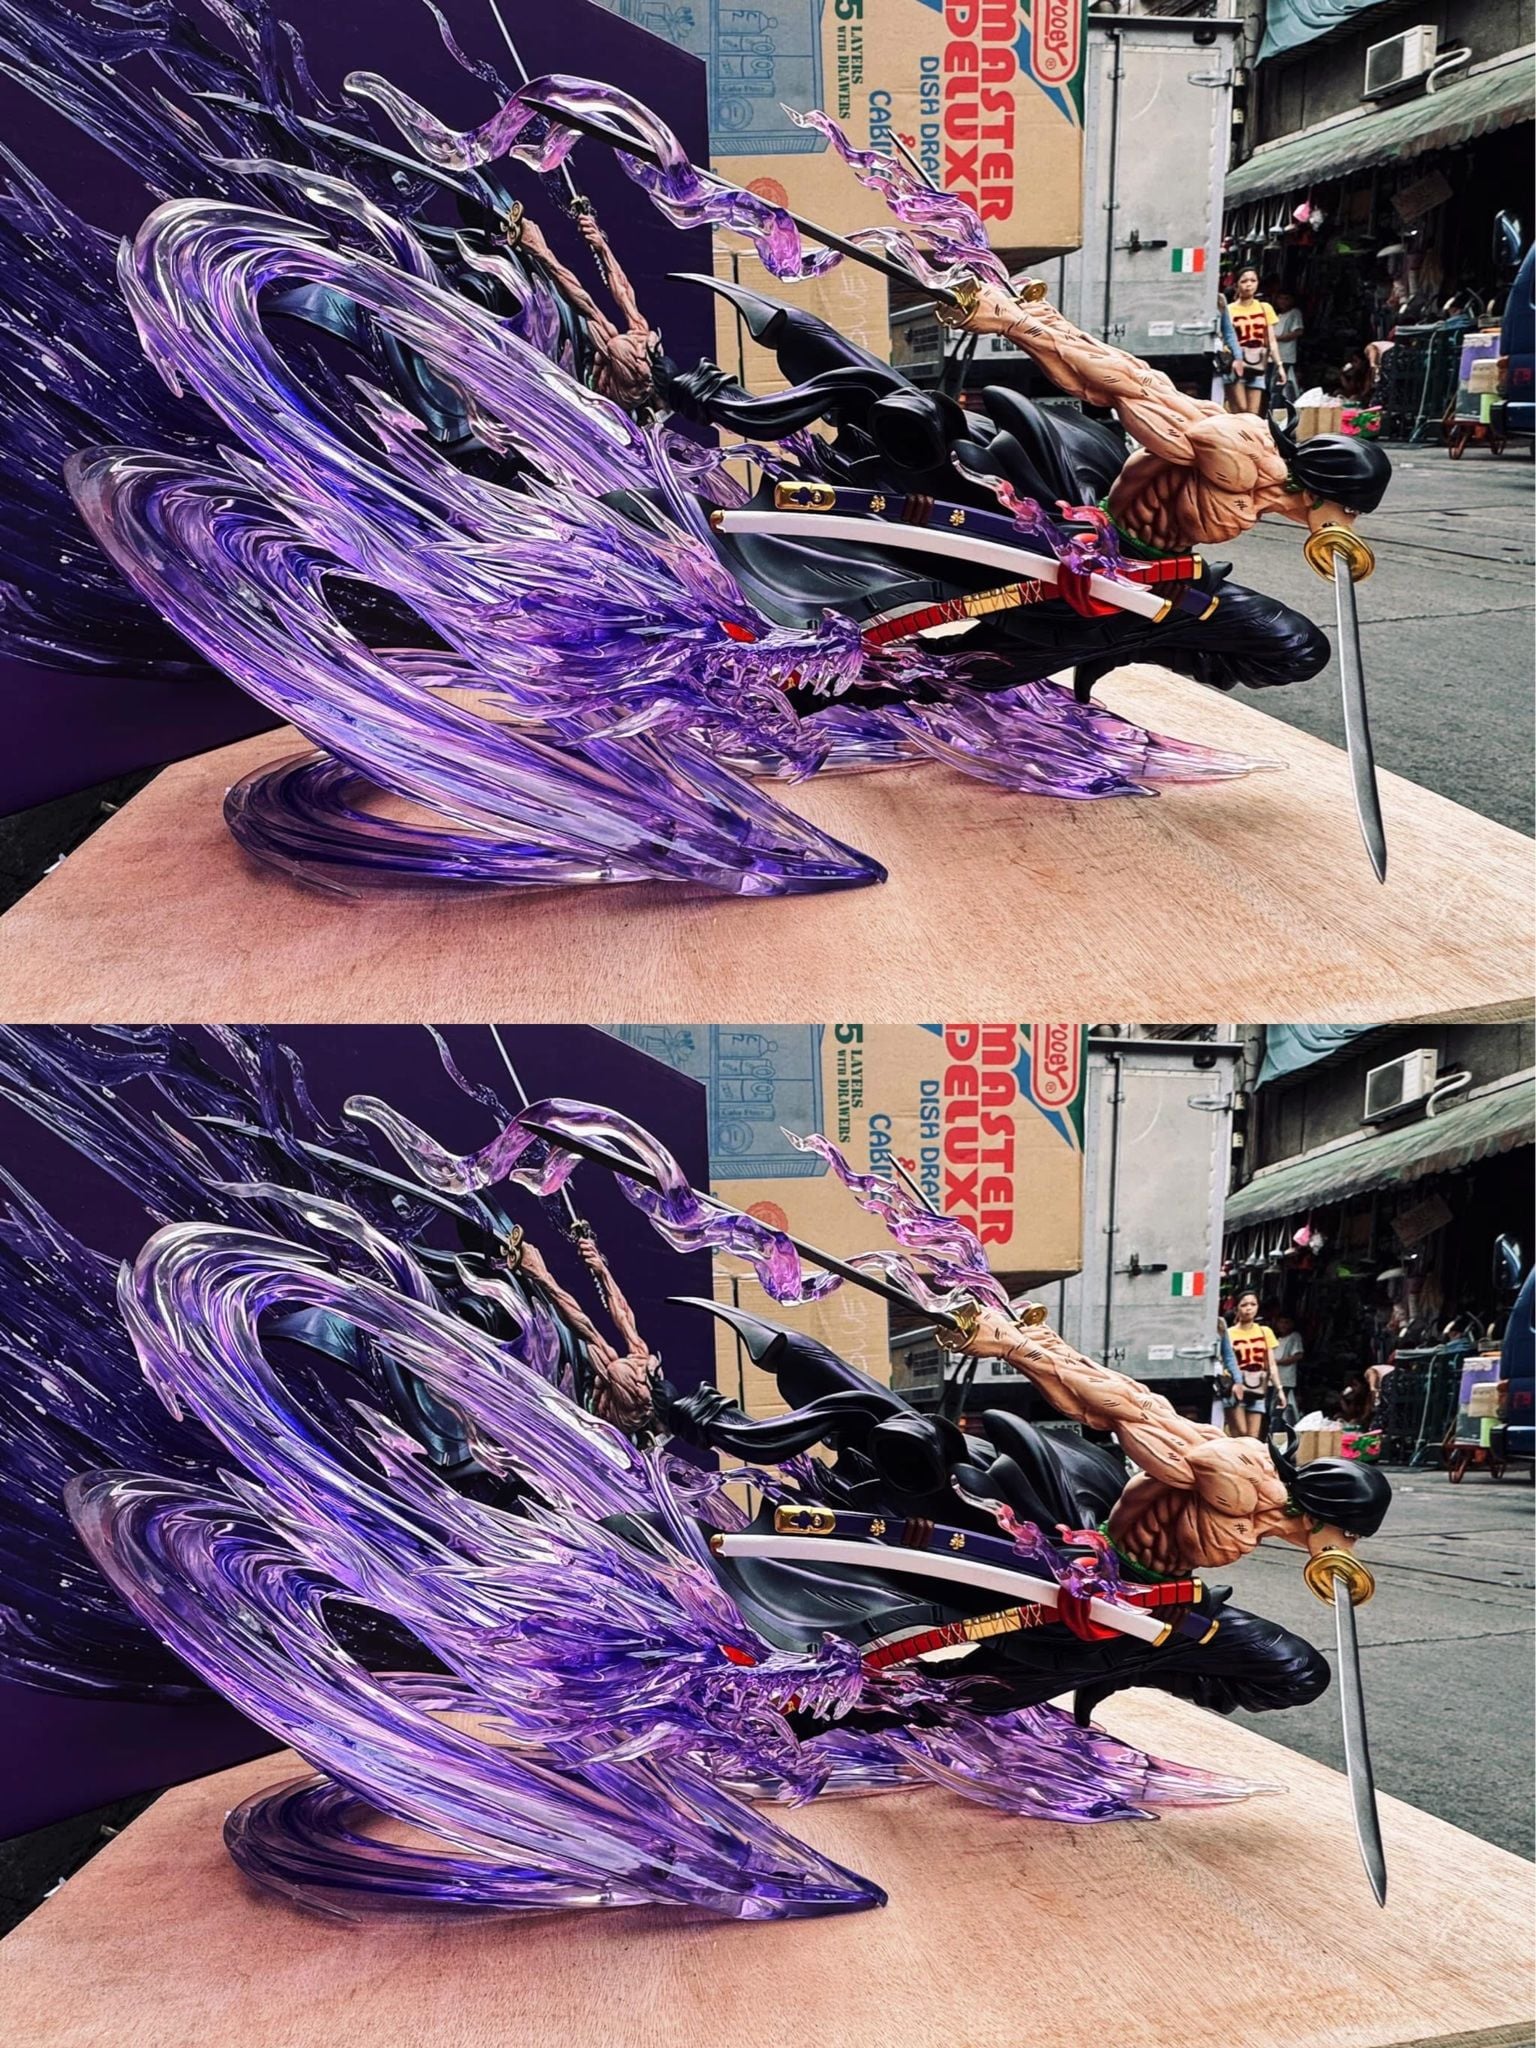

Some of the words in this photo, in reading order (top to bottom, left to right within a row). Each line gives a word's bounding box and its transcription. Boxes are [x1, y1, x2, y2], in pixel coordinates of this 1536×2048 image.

[838, 26, 846, 51] WITH
[851, 26, 863, 85] LAYERS
[1045, 0, 1069, 67] ooey
[838, 56, 850, 119] DRAWERS
[920, 57, 939, 115] DISH
[944, 0, 979, 213] DELUX
[981, 0, 1017, 222] MASTER
[838, 1050, 846, 1075] WITH
[851, 1050, 863, 1109] LAYERS
[1045, 1024, 1069, 1091] ooey
[838, 1080, 850, 1143] DRAWERS
[920, 1081, 939, 1139] DISH
[944, 1024, 979, 1237] DELUX
[981, 1024, 1017, 1246] MASTER
